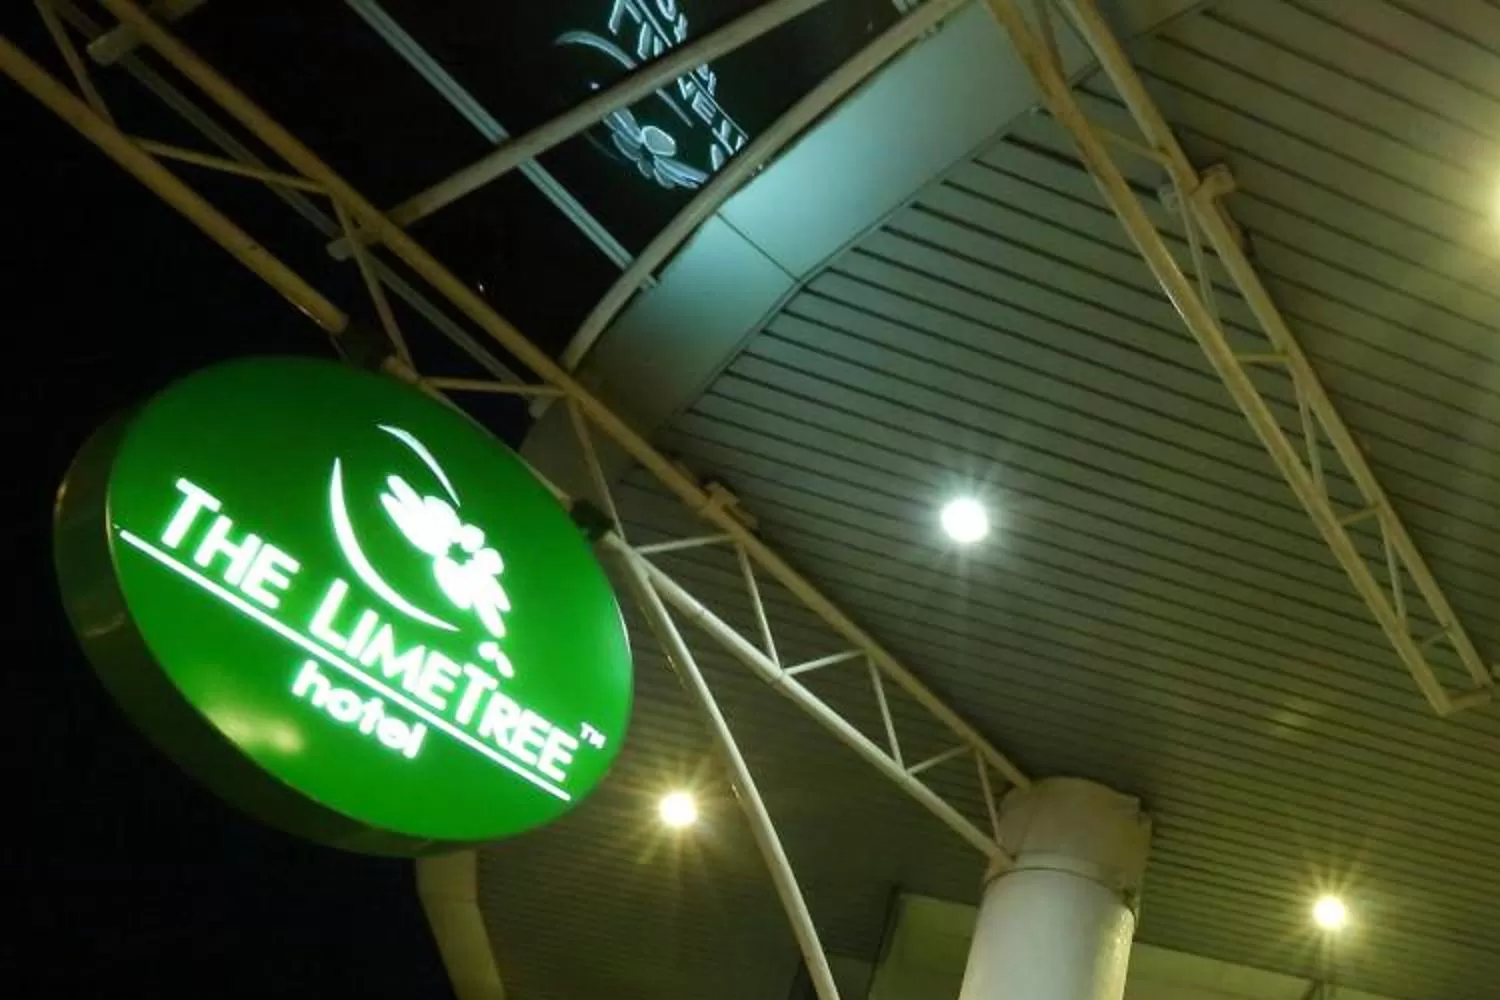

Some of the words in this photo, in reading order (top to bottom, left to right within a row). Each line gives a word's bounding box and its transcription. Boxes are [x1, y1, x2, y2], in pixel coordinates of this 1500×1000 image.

[160, 476, 302, 608] THE
[308, 577, 580, 783] LIMETREE
[290, 658, 428, 760] hotel
